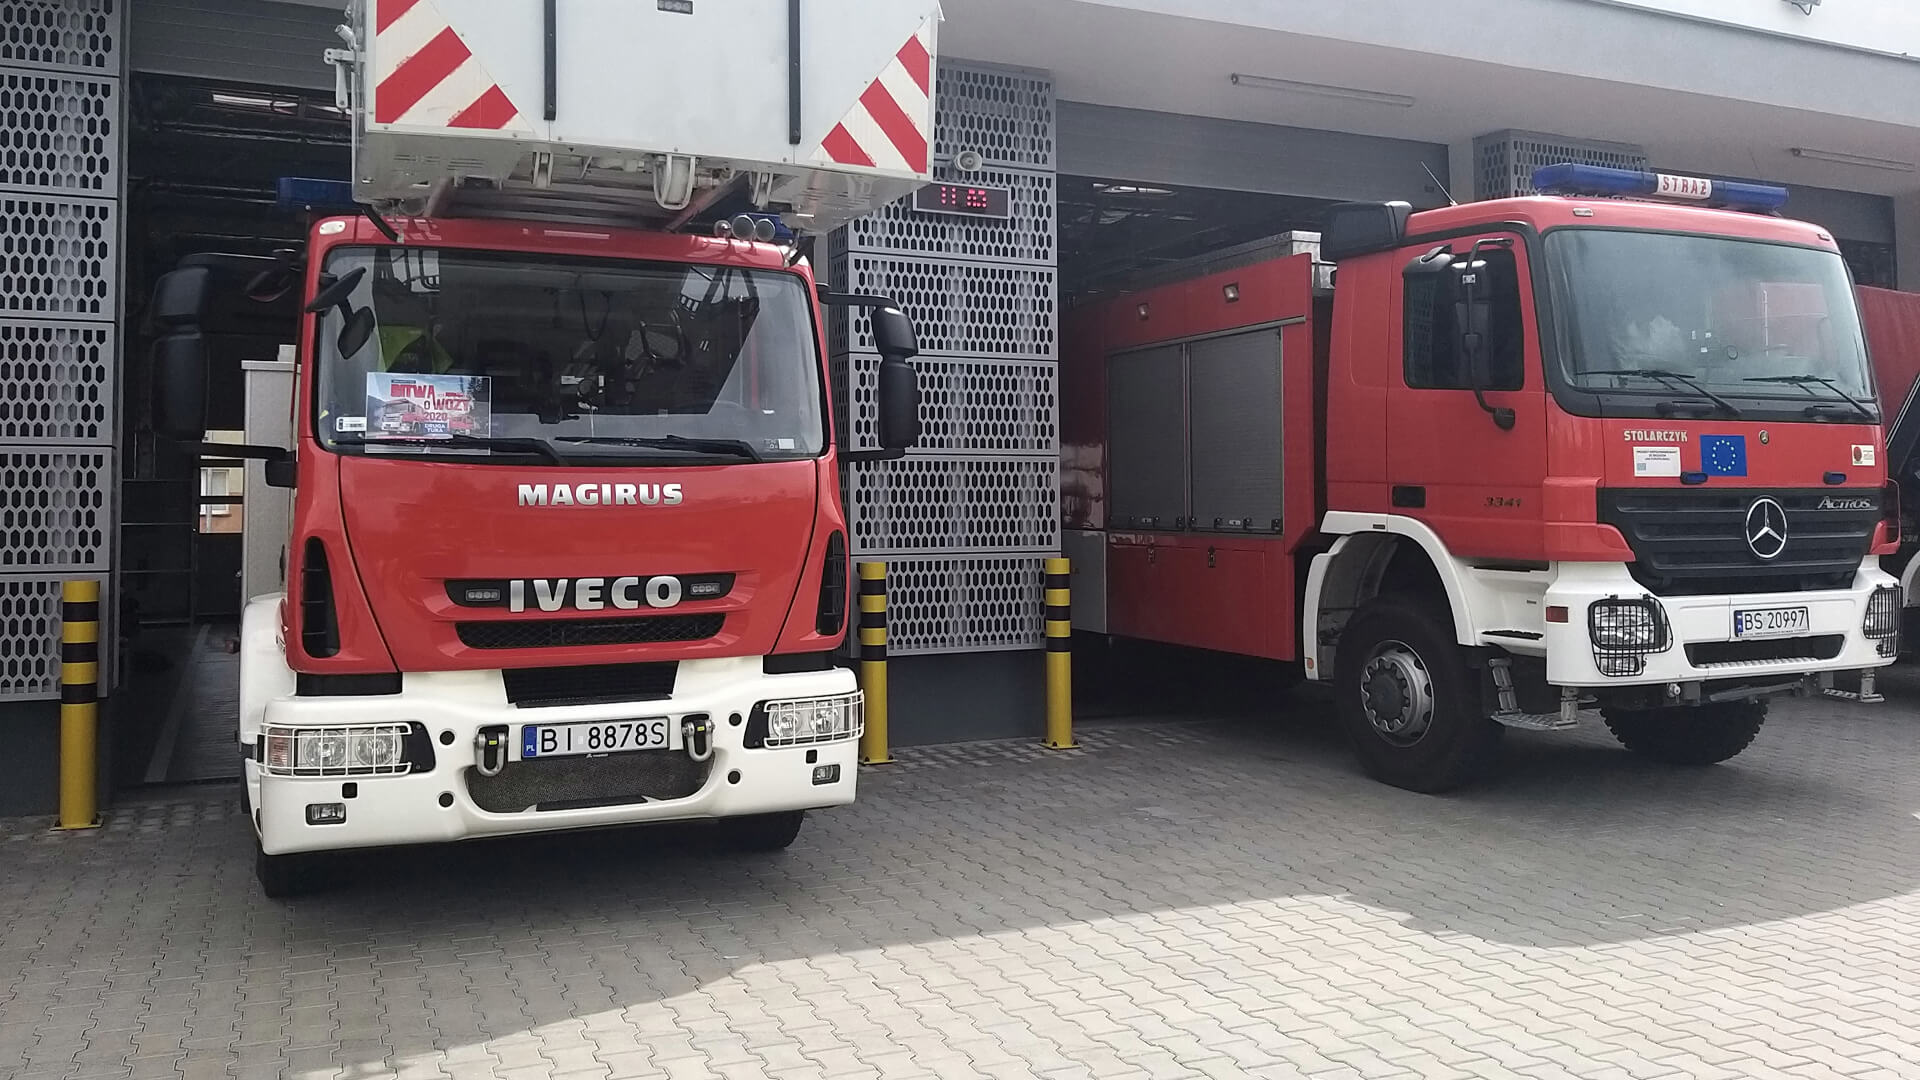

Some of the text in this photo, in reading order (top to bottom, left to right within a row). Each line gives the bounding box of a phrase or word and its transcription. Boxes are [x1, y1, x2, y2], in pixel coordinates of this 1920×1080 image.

[1624, 430, 1688, 442] STOLARCZYK
[518, 484, 683, 506] MAGIRUS
[510, 576, 682, 612] IVECO
[1744, 613, 1763, 630] BS
[1767, 610, 1805, 628] 20997
[588, 722, 664, 749] 8878S
